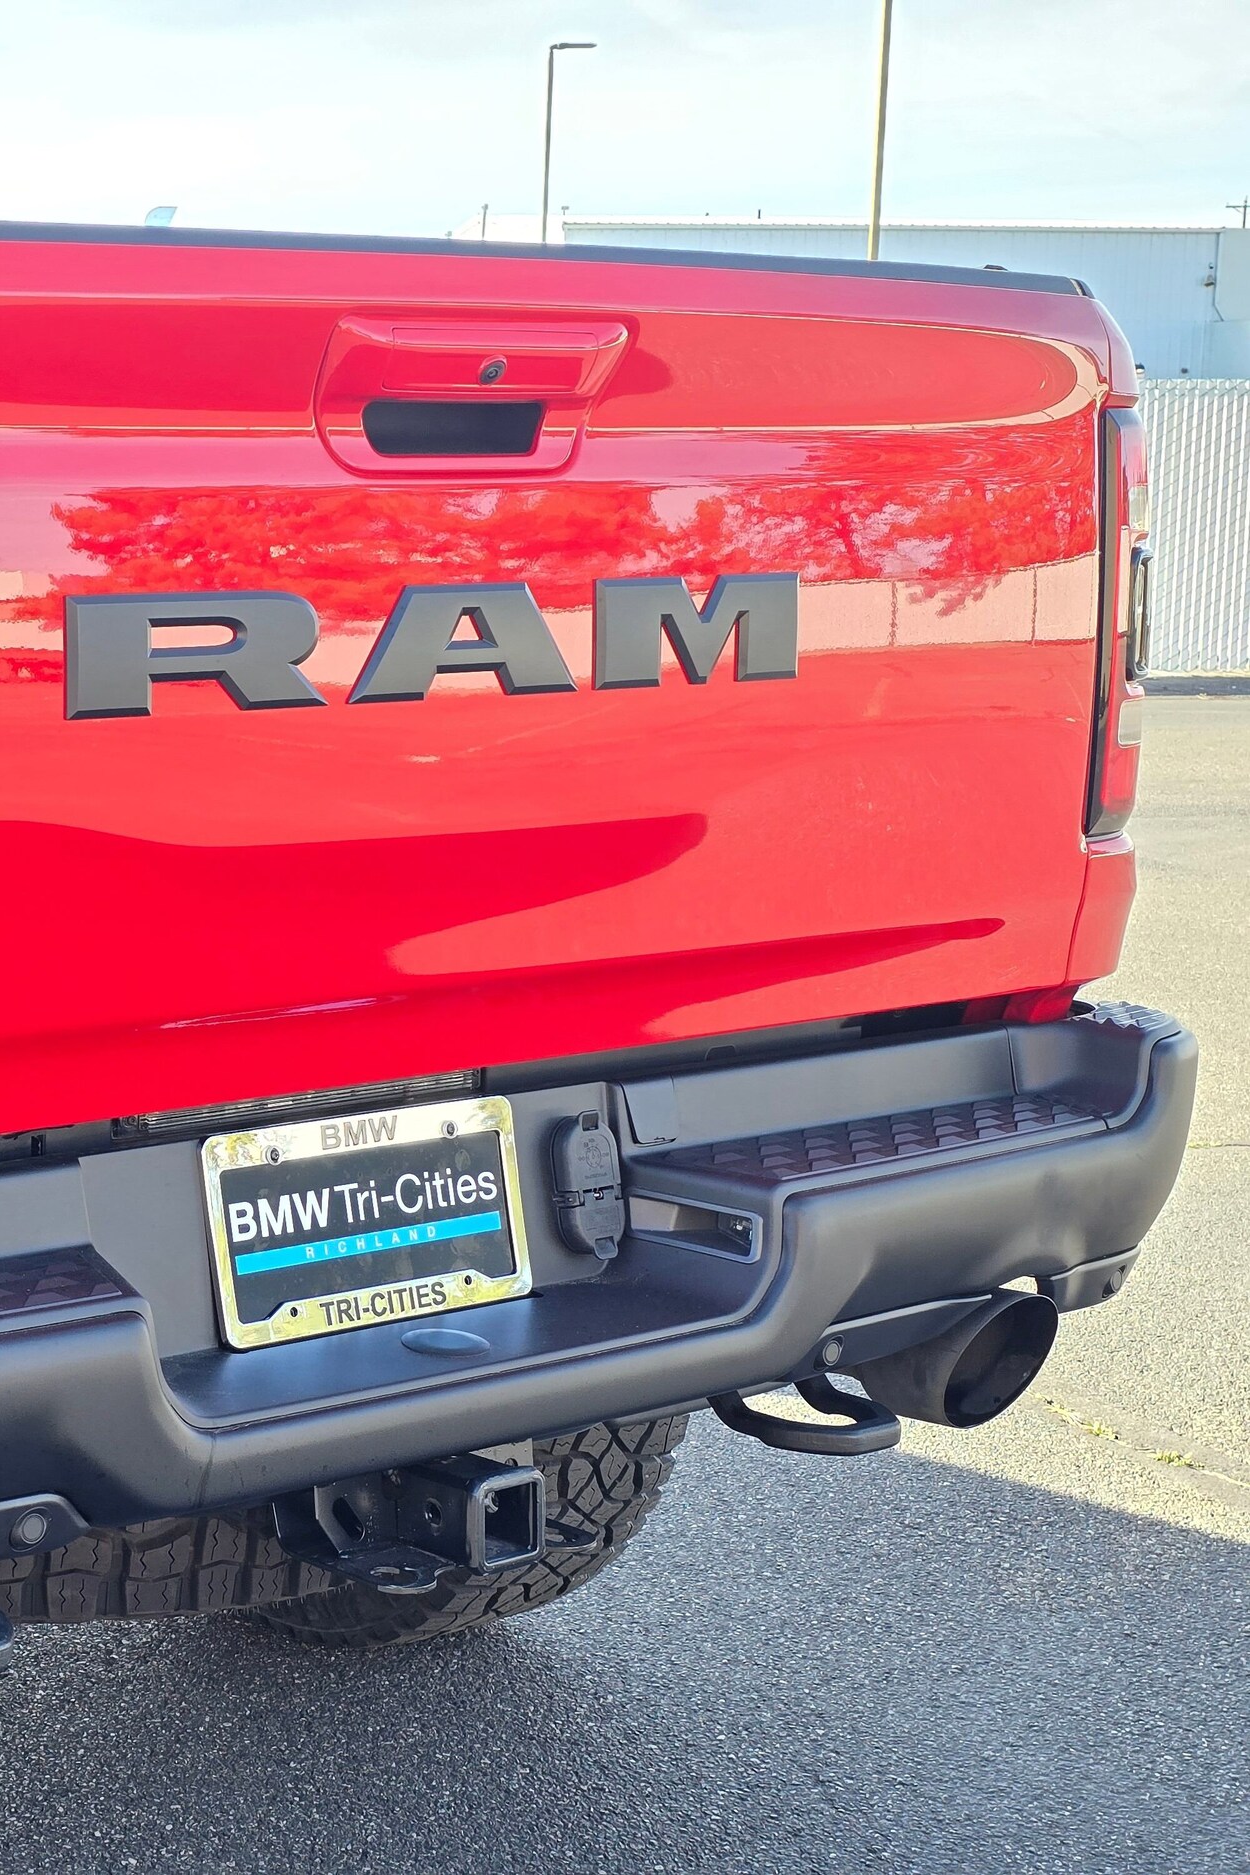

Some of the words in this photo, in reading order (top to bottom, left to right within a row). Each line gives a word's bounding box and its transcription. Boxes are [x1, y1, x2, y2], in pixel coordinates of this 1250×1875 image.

[63, 571, 800, 719] RAM
[320, 1115, 398, 1150] BMW
[228, 1188, 330, 1243] BMW
[334, 1167, 498, 1224] Tri-Cities
[306, 1225, 437, 1259] RICHLAND
[319, 1281, 448, 1326] TRI-CITIES
